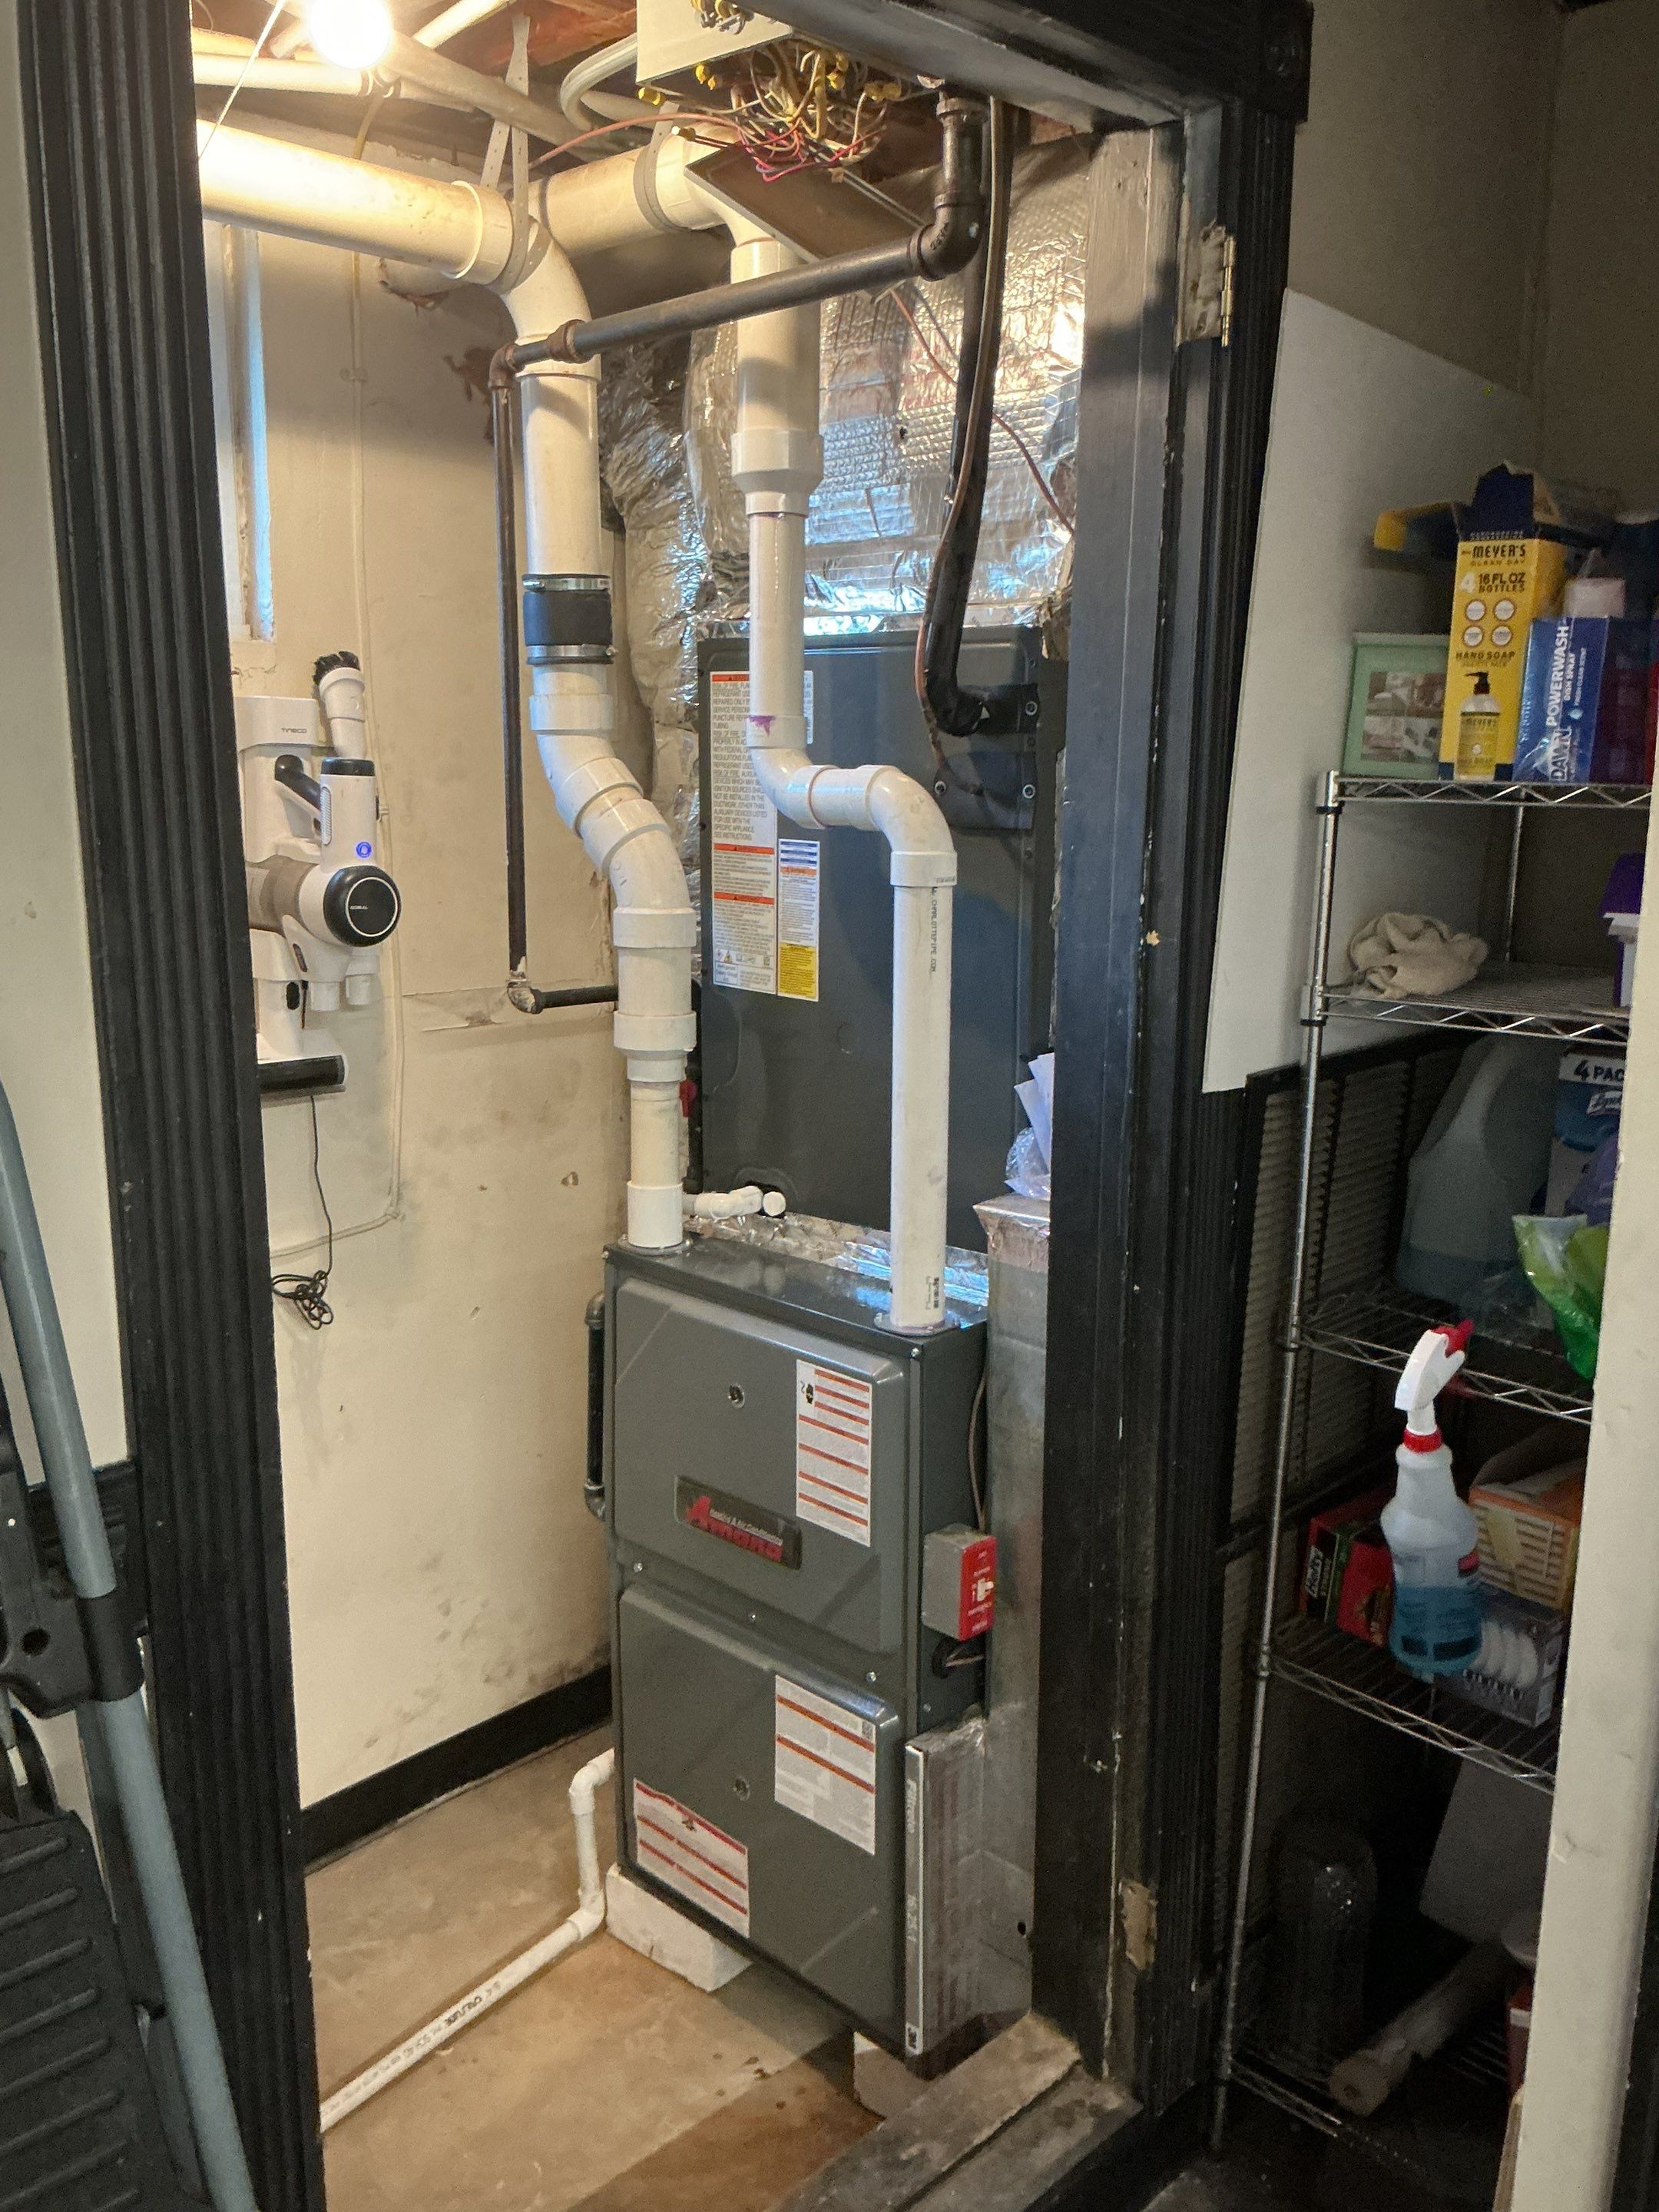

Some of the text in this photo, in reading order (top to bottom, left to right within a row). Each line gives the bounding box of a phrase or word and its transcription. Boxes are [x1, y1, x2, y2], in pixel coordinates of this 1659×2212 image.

[1472, 544, 1526, 558] MEYER'S
[1460, 571, 1475, 594] 4
[1479, 572, 1526, 584] 16 FL OZ
[1479, 584, 1525, 594] BOTTLES
[1455, 651, 1515, 661] HAND SOAP
[1565, 652, 1575, 680] SPRAY
[1545, 625, 1570, 727] POWERWASH
[1547, 727, 1571, 782] DAWN
[1574, 1059, 1590, 1081] 4
